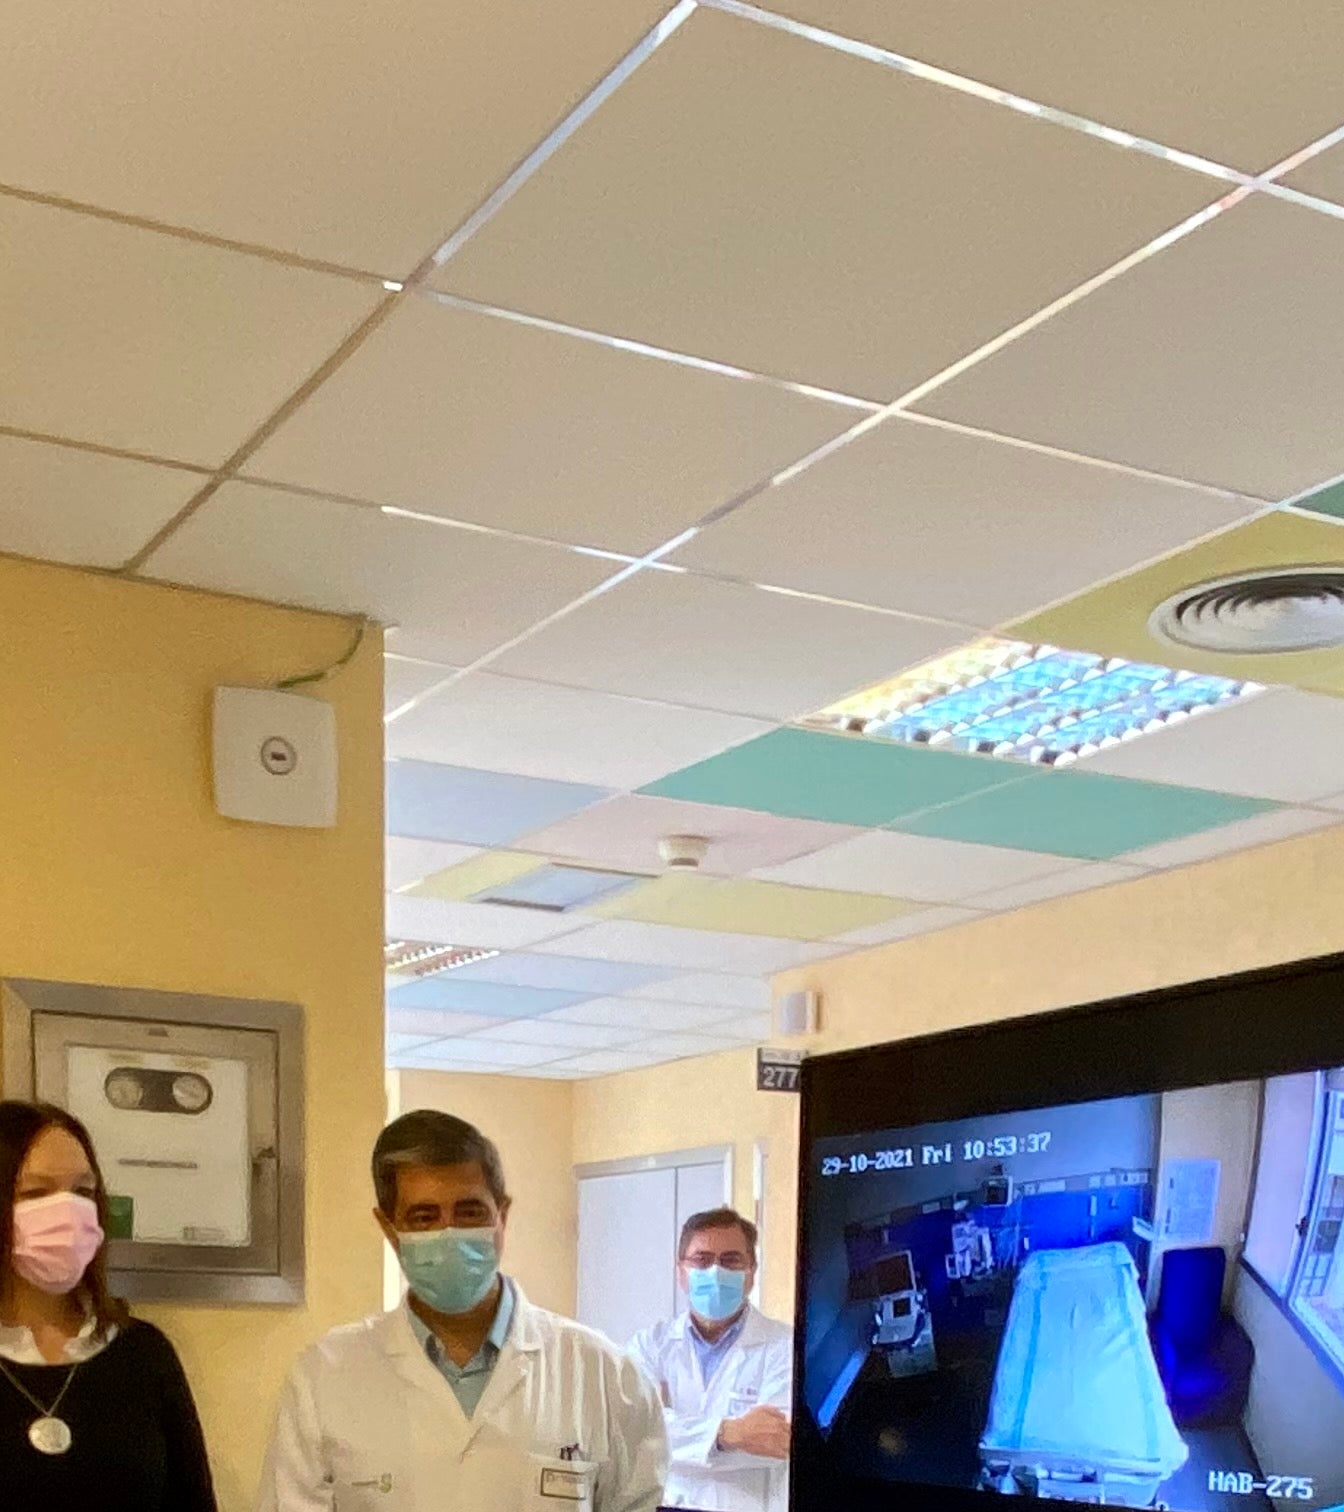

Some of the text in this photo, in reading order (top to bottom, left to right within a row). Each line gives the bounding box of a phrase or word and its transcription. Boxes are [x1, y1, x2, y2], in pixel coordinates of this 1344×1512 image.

[763, 1066, 799, 1089] 277
[821, 1131, 1052, 1176] 29-10-2021 Fri 10:53:37
[1208, 1470, 1314, 1500] HAB-275
